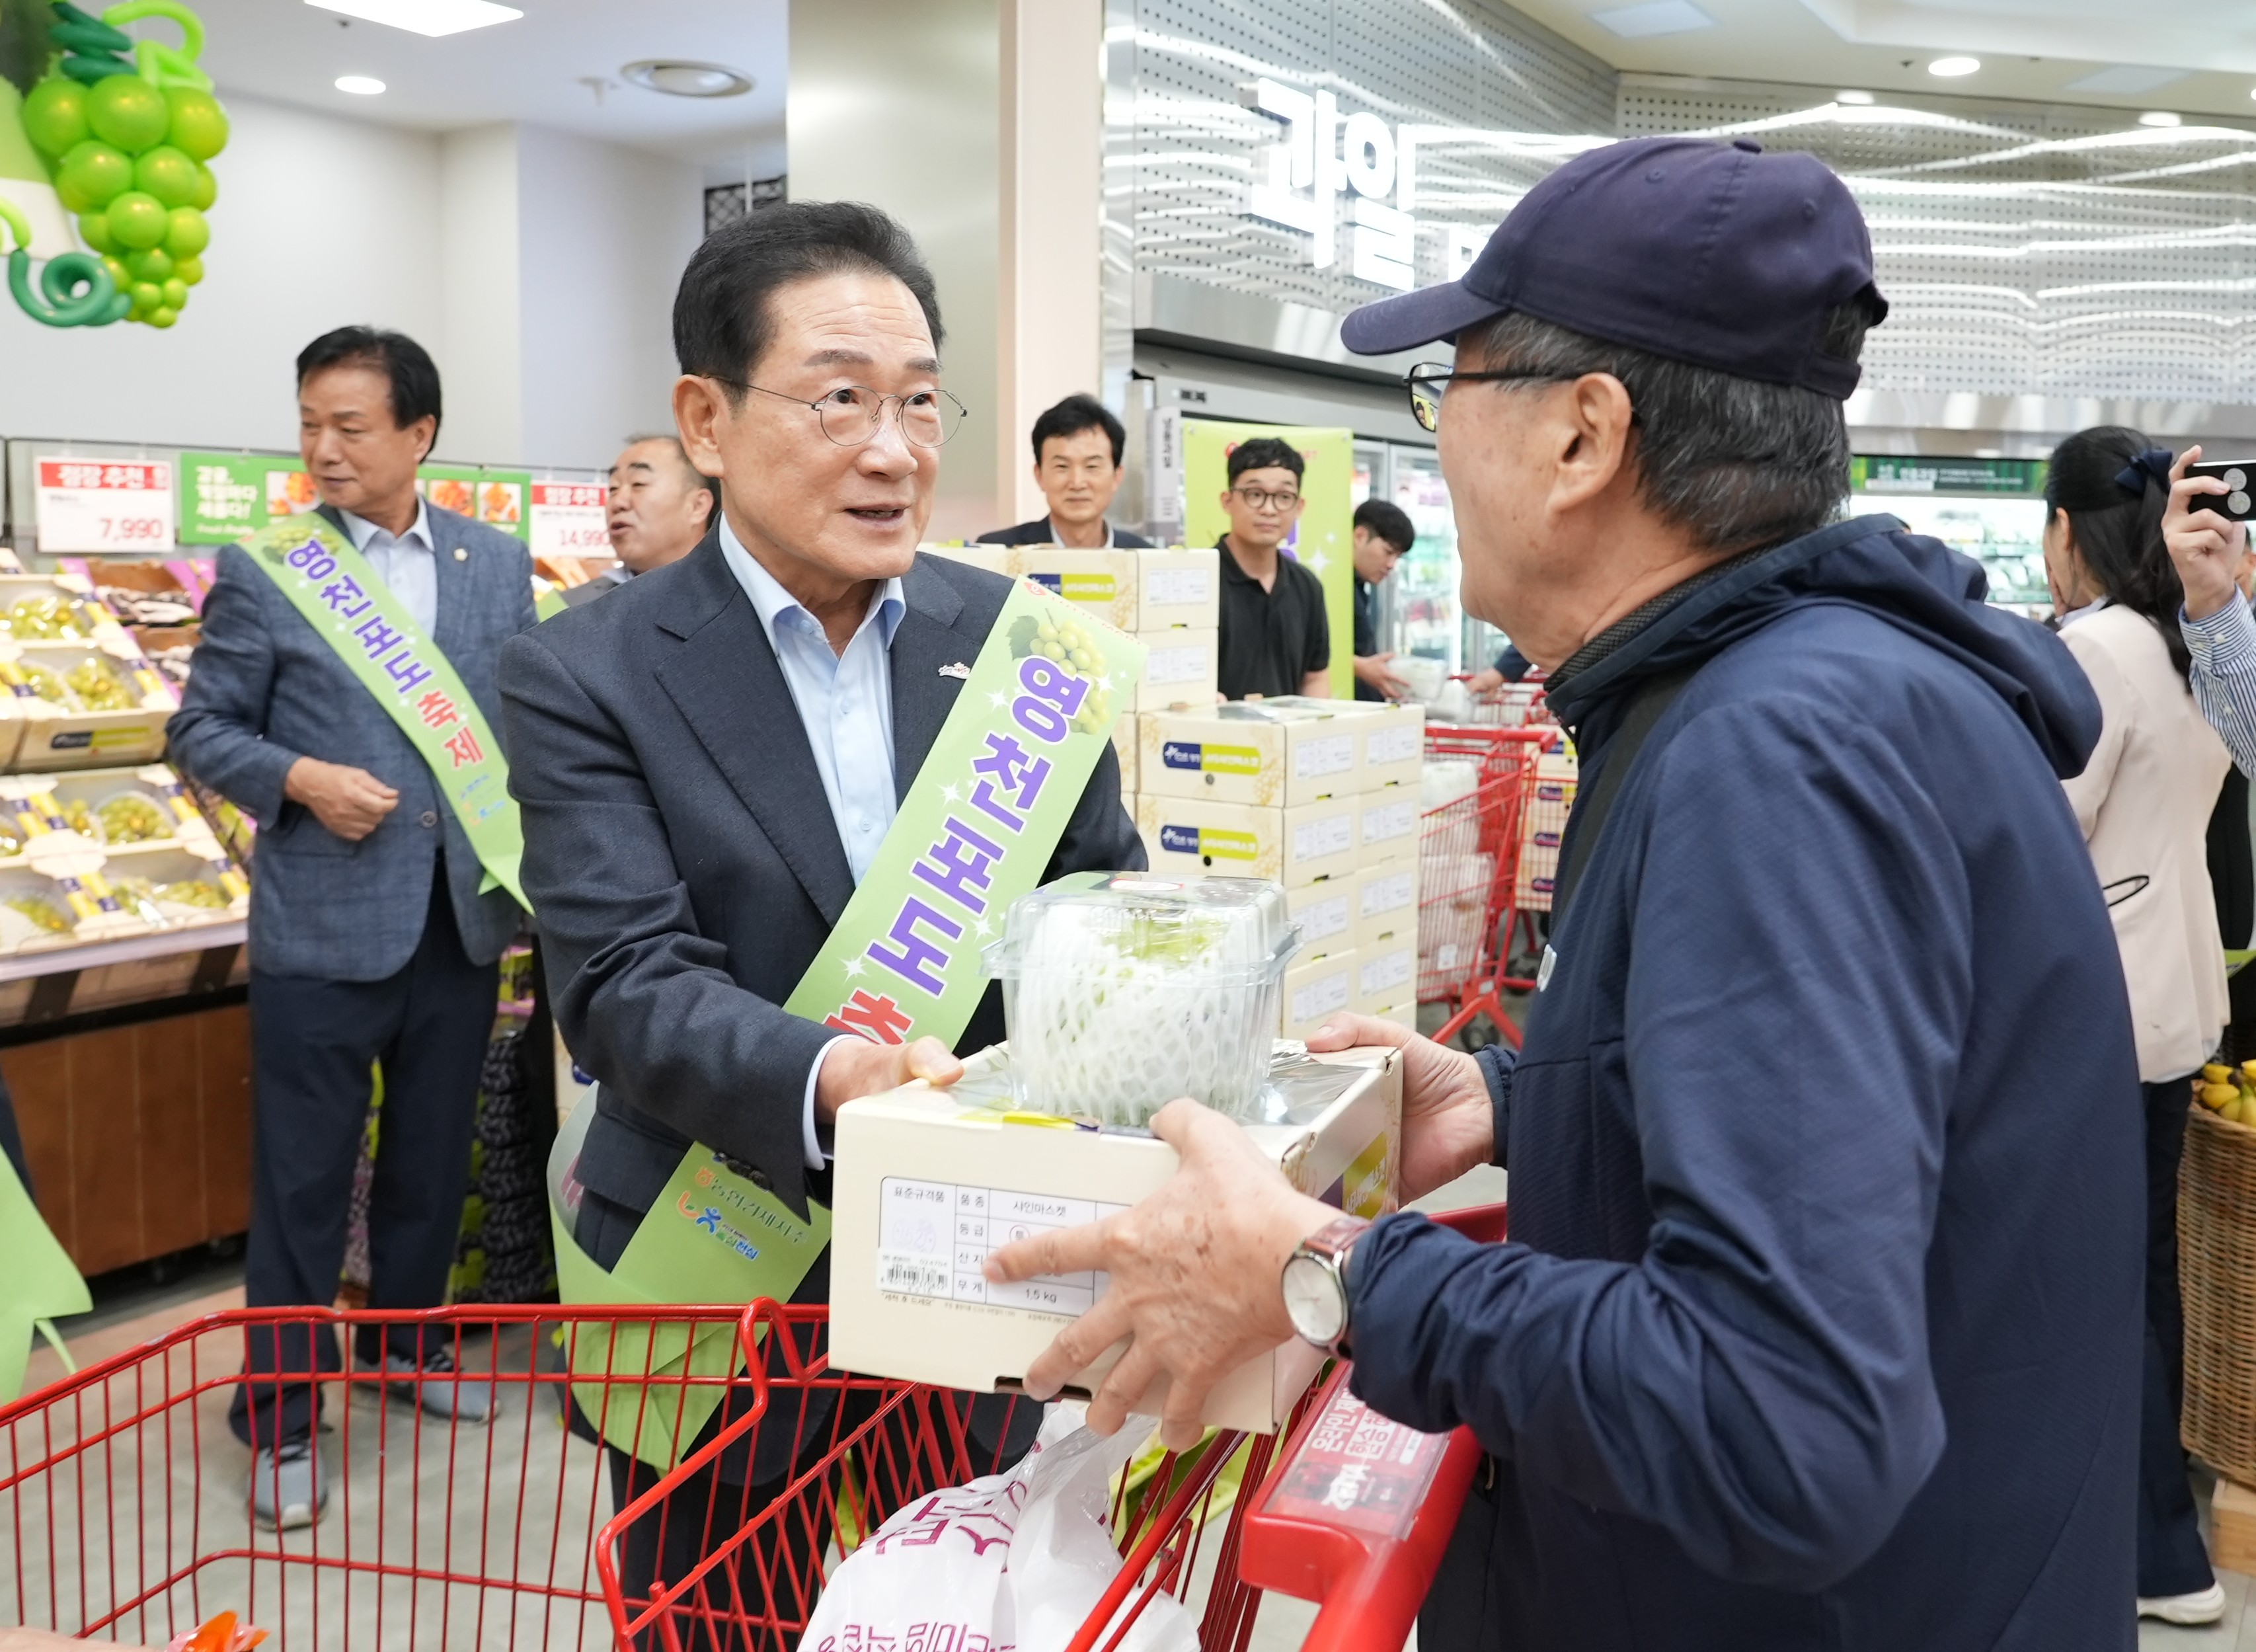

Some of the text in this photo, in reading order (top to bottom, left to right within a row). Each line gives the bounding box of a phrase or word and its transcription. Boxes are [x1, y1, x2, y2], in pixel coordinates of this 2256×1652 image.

[1251, 77, 1415, 292] 과일
[100, 518, 163, 541] 7,990
[417, 689, 485, 769] 축제
[867, 656, 1091, 998] 영천포도
[894, 1187, 945, 1202] 표준규격품
[1044, 1290, 1057, 1304] kg
[1311, 1413, 1358, 1452] 온라인
